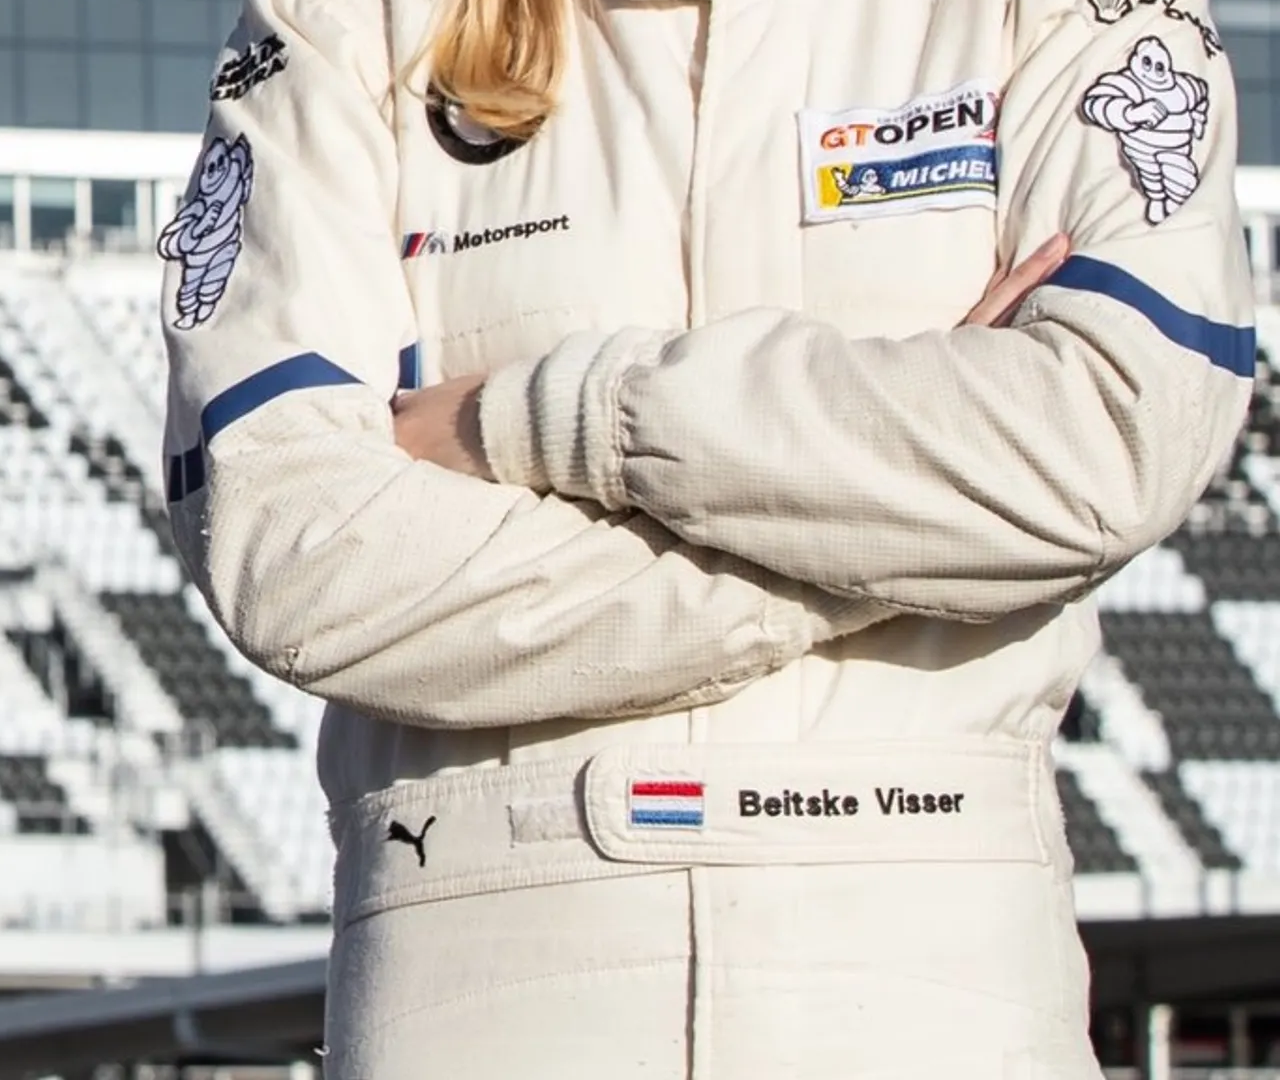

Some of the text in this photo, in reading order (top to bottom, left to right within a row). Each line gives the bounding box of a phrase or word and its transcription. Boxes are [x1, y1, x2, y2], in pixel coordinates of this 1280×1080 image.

[453, 214, 570, 253] Motorsport
[738, 787, 965, 817] Beitske Visser
